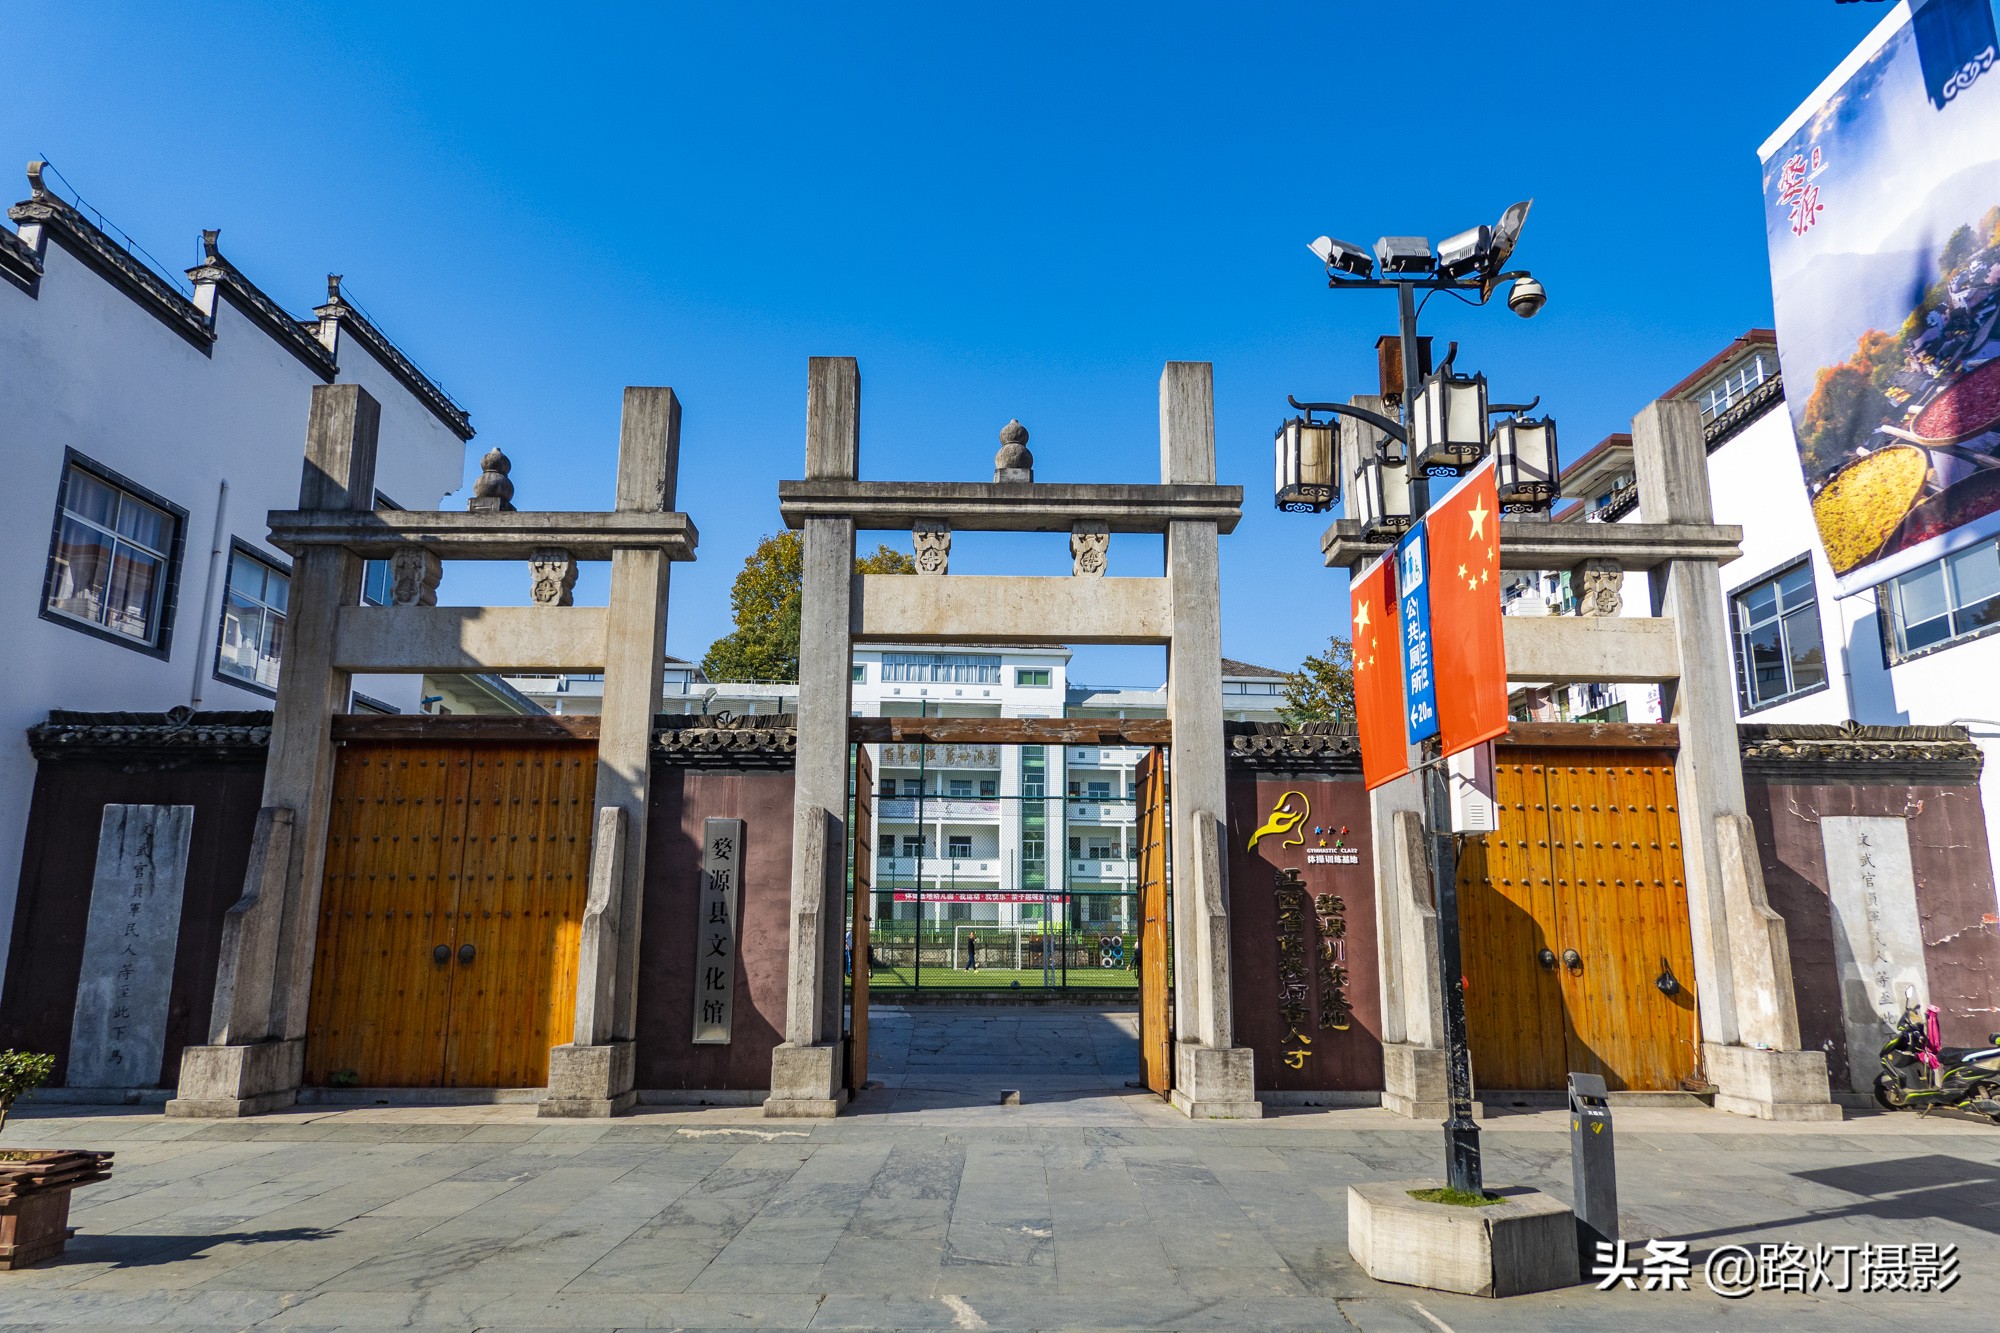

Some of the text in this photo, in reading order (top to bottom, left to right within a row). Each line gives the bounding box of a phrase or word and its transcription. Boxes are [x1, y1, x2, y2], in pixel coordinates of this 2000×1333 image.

[1405, 597, 1421, 695] 公共厕所
[1418, 701, 1433, 723] 20m
[1307, 855, 1359, 864] 体操训练基地
[702, 836, 733, 1025] 婺源县文化馆
[1275, 868, 1312, 1069] 江西省体操后备人才
[1315, 892, 1351, 1031] 婺源训练基地
